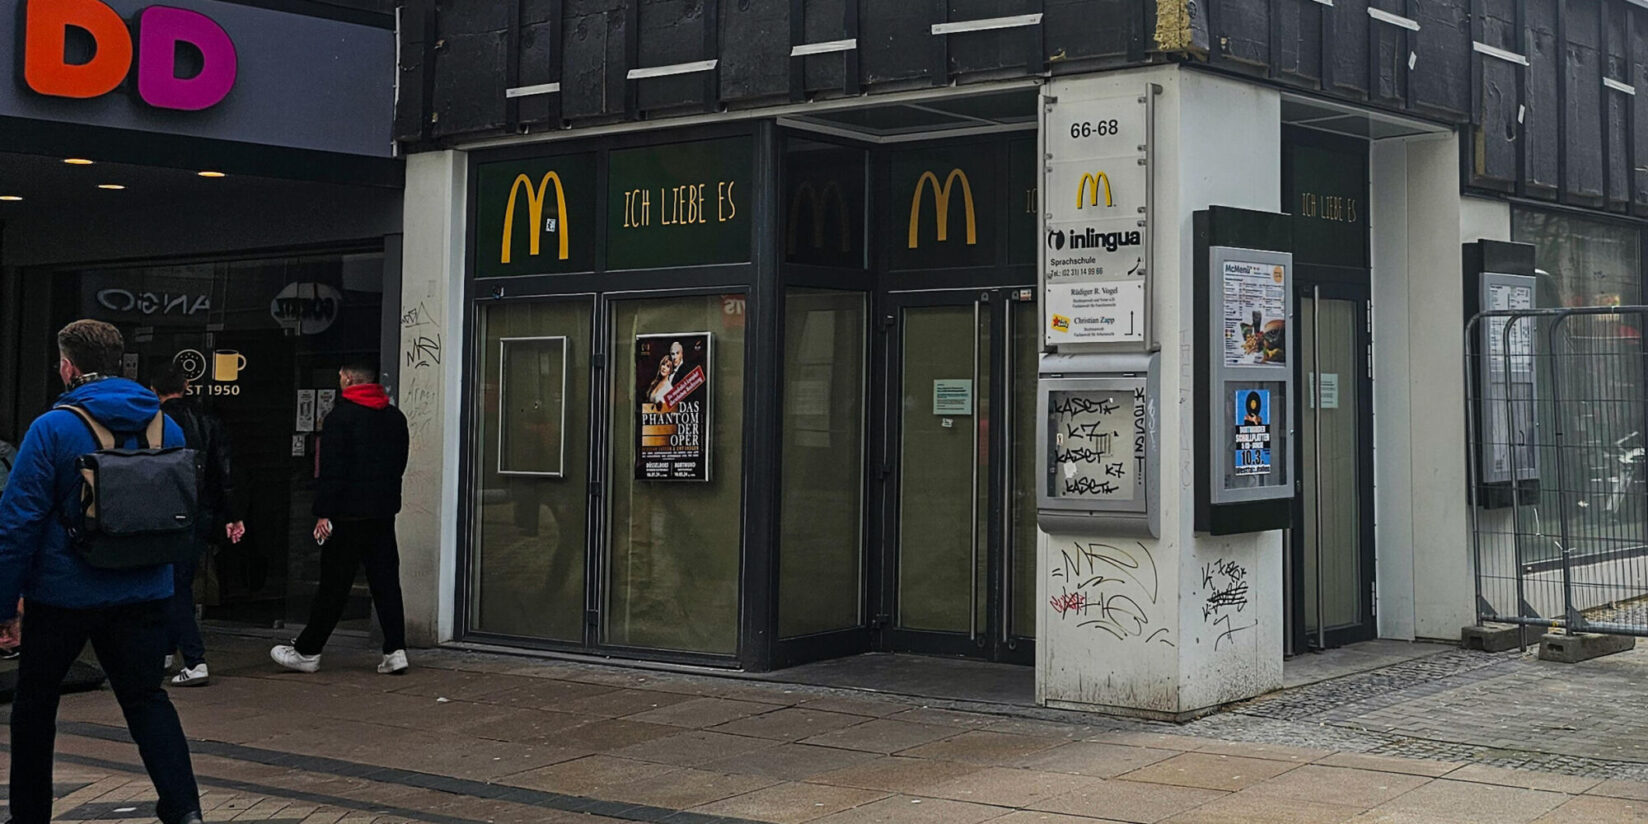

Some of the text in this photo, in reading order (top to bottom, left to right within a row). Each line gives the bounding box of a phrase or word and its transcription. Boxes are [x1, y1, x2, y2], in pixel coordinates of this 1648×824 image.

[1070, 119, 1119, 139] 66-68
[623, 181, 736, 228] ICH LIEBE ES
[1302, 192, 1357, 223] ICH LIEBE ES
[1070, 227, 1141, 252] inlingua
[1050, 256, 1097, 267] Sprachschule
[1102, 286, 1119, 296] Vogel
[207, 384, 240, 396] 1950
[679, 401, 700, 413] DAS
[642, 412, 700, 425] PHANTOM
[677, 423, 700, 435] DER
[670, 435, 700, 447] OPER
[1241, 450, 1264, 466] 10.3.
